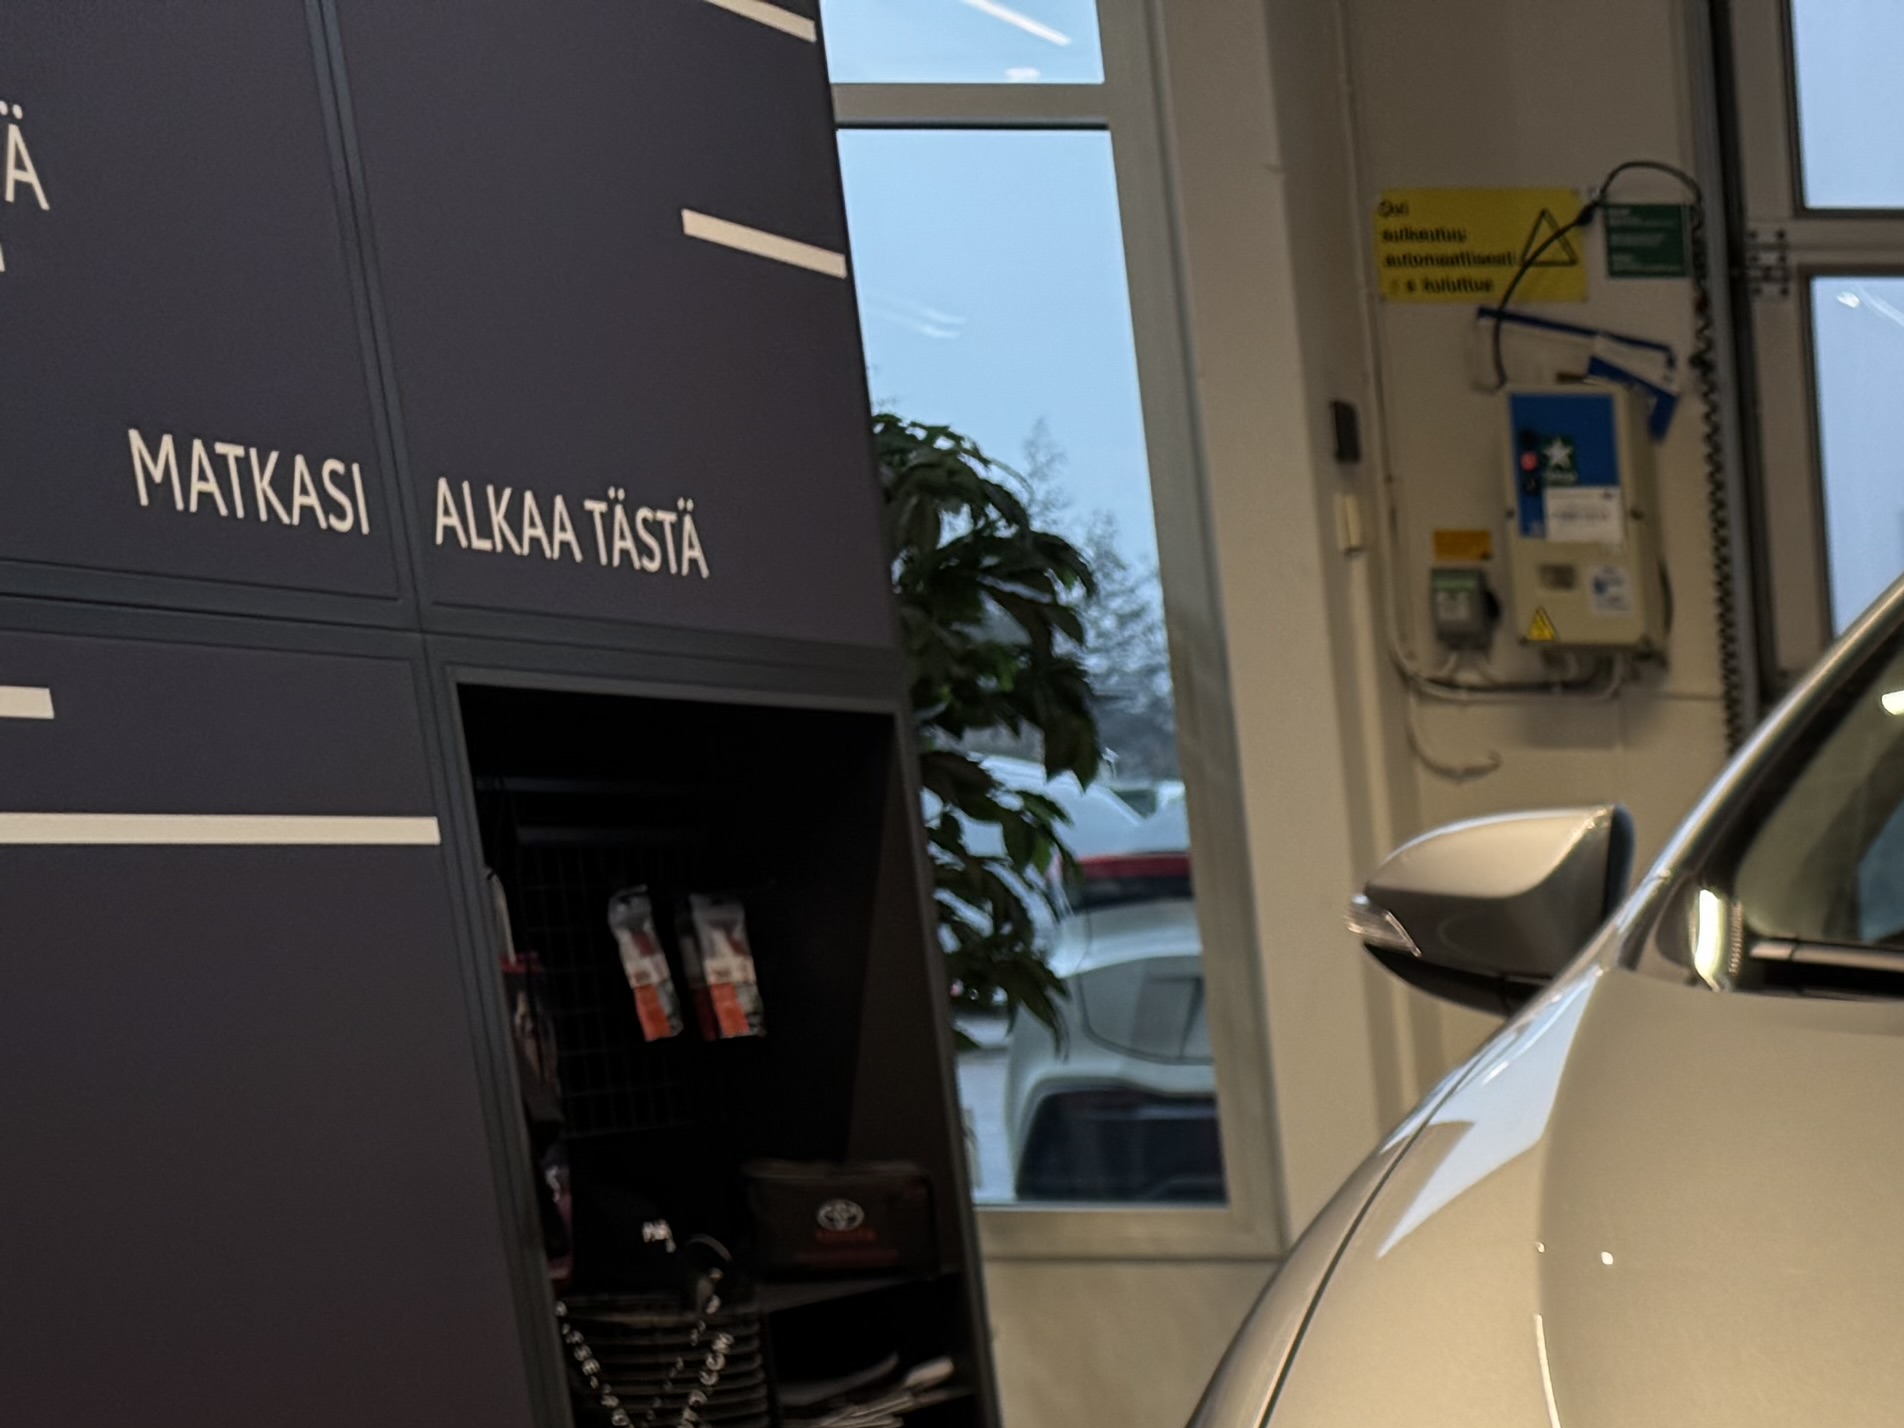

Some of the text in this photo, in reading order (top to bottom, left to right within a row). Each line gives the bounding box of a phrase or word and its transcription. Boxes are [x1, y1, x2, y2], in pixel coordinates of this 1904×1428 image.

[128, 428, 711, 580] MATKASI ALKAA TÄSTÄ
